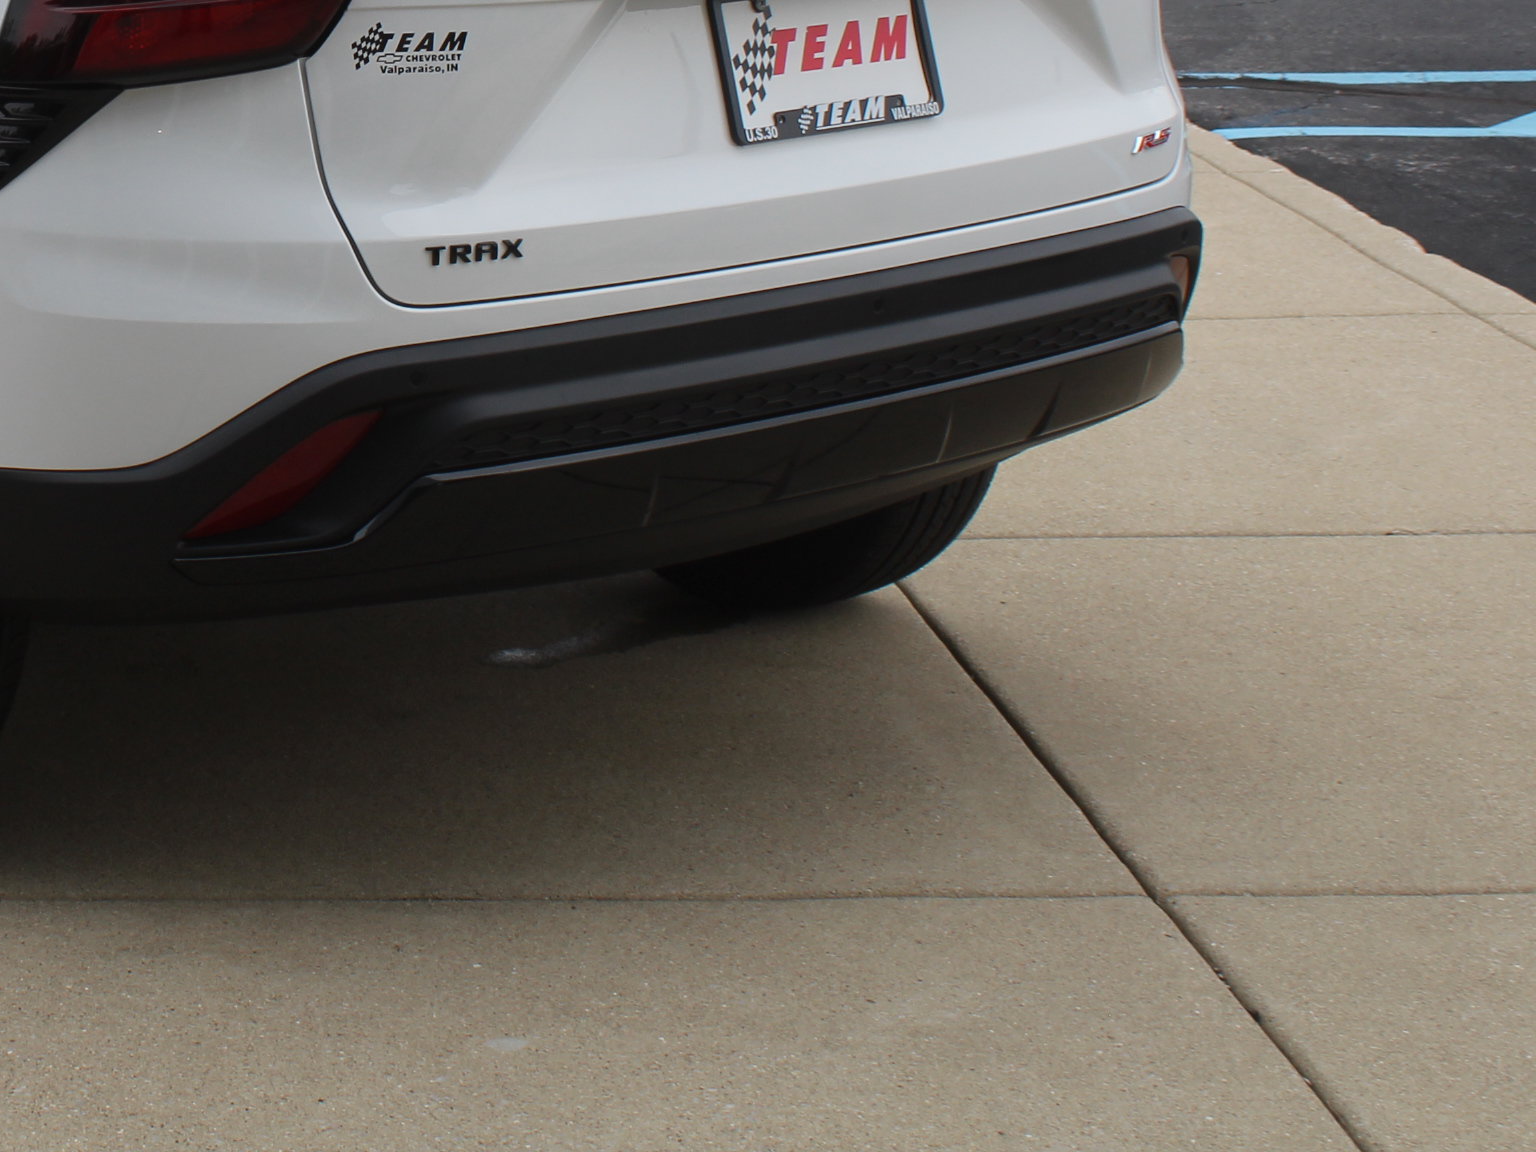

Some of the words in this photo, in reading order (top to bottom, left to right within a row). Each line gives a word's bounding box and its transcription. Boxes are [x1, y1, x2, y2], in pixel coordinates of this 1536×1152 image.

[378, 32, 468, 52] TEAM
[770, 14, 908, 75] TEAM
[380, 64, 445, 76] Valparaiso,
[447, 63, 459, 72] IN
[405, 54, 462, 63] CHEVROLET
[814, 96, 887, 128] TEAM
[891, 101, 940, 121] VALPARAISO
[1131, 127, 1171, 155] RS
[425, 238, 524, 266] TRAX
